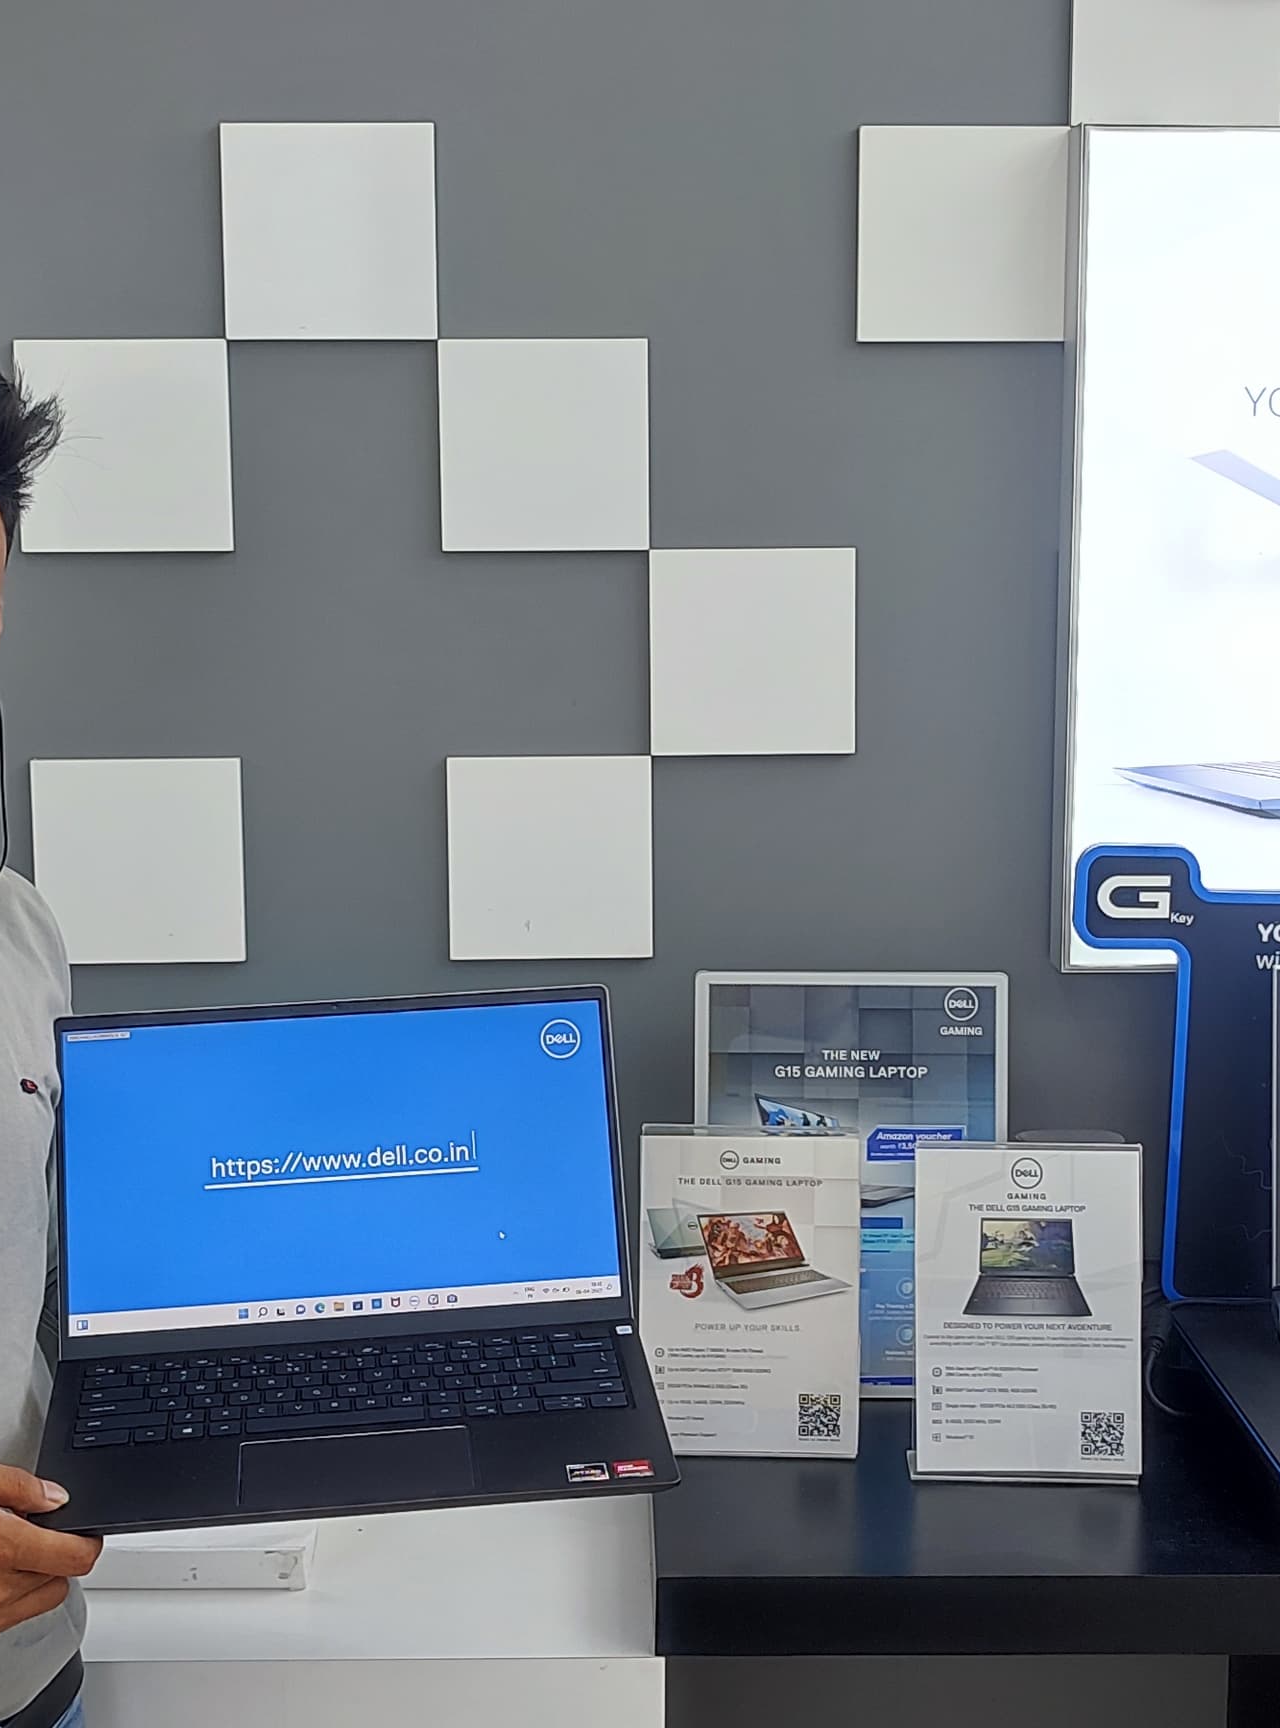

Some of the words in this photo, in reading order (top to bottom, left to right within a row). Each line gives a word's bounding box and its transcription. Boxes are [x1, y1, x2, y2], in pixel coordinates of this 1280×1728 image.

[1097, 874, 1172, 919] G
[1170, 912, 1195, 926] Key
[949, 999, 974, 1009] DELL
[940, 1026, 983, 1036] GAMING
[546, 1033, 577, 1045] DELL
[822, 1050, 848, 1061] THE
[851, 1050, 881, 1061] NEW
[774, 1065, 801, 1078] G15
[804, 1066, 866, 1079] GAMING
[869, 1066, 928, 1079] LAPTOP
[876, 1131, 914, 1140] Amazon
[211, 1141, 470, 1181] https://www.dell.co.in
[742, 1157, 782, 1165] GAMING
[1015, 1169, 1039, 1178] DELL
[678, 1177, 696, 1186] THE
[699, 1177, 721, 1186] DELL
[725, 1178, 742, 1186] G15
[745, 1178, 783, 1187] GAMING
[786, 1179, 824, 1187] LAPTOP
[1006, 1192, 1047, 1200] GAMING
[968, 1203, 984, 1212] THE
[985, 1204, 1005, 1212] DELL
[1021, 1204, 1054, 1213] GAMING
[1055, 1205, 1087, 1213] LAPTOP
[694, 1322, 726, 1331] POWER
[728, 1323, 742, 1331] UP
[744, 1324, 768, 1332] YOUR
